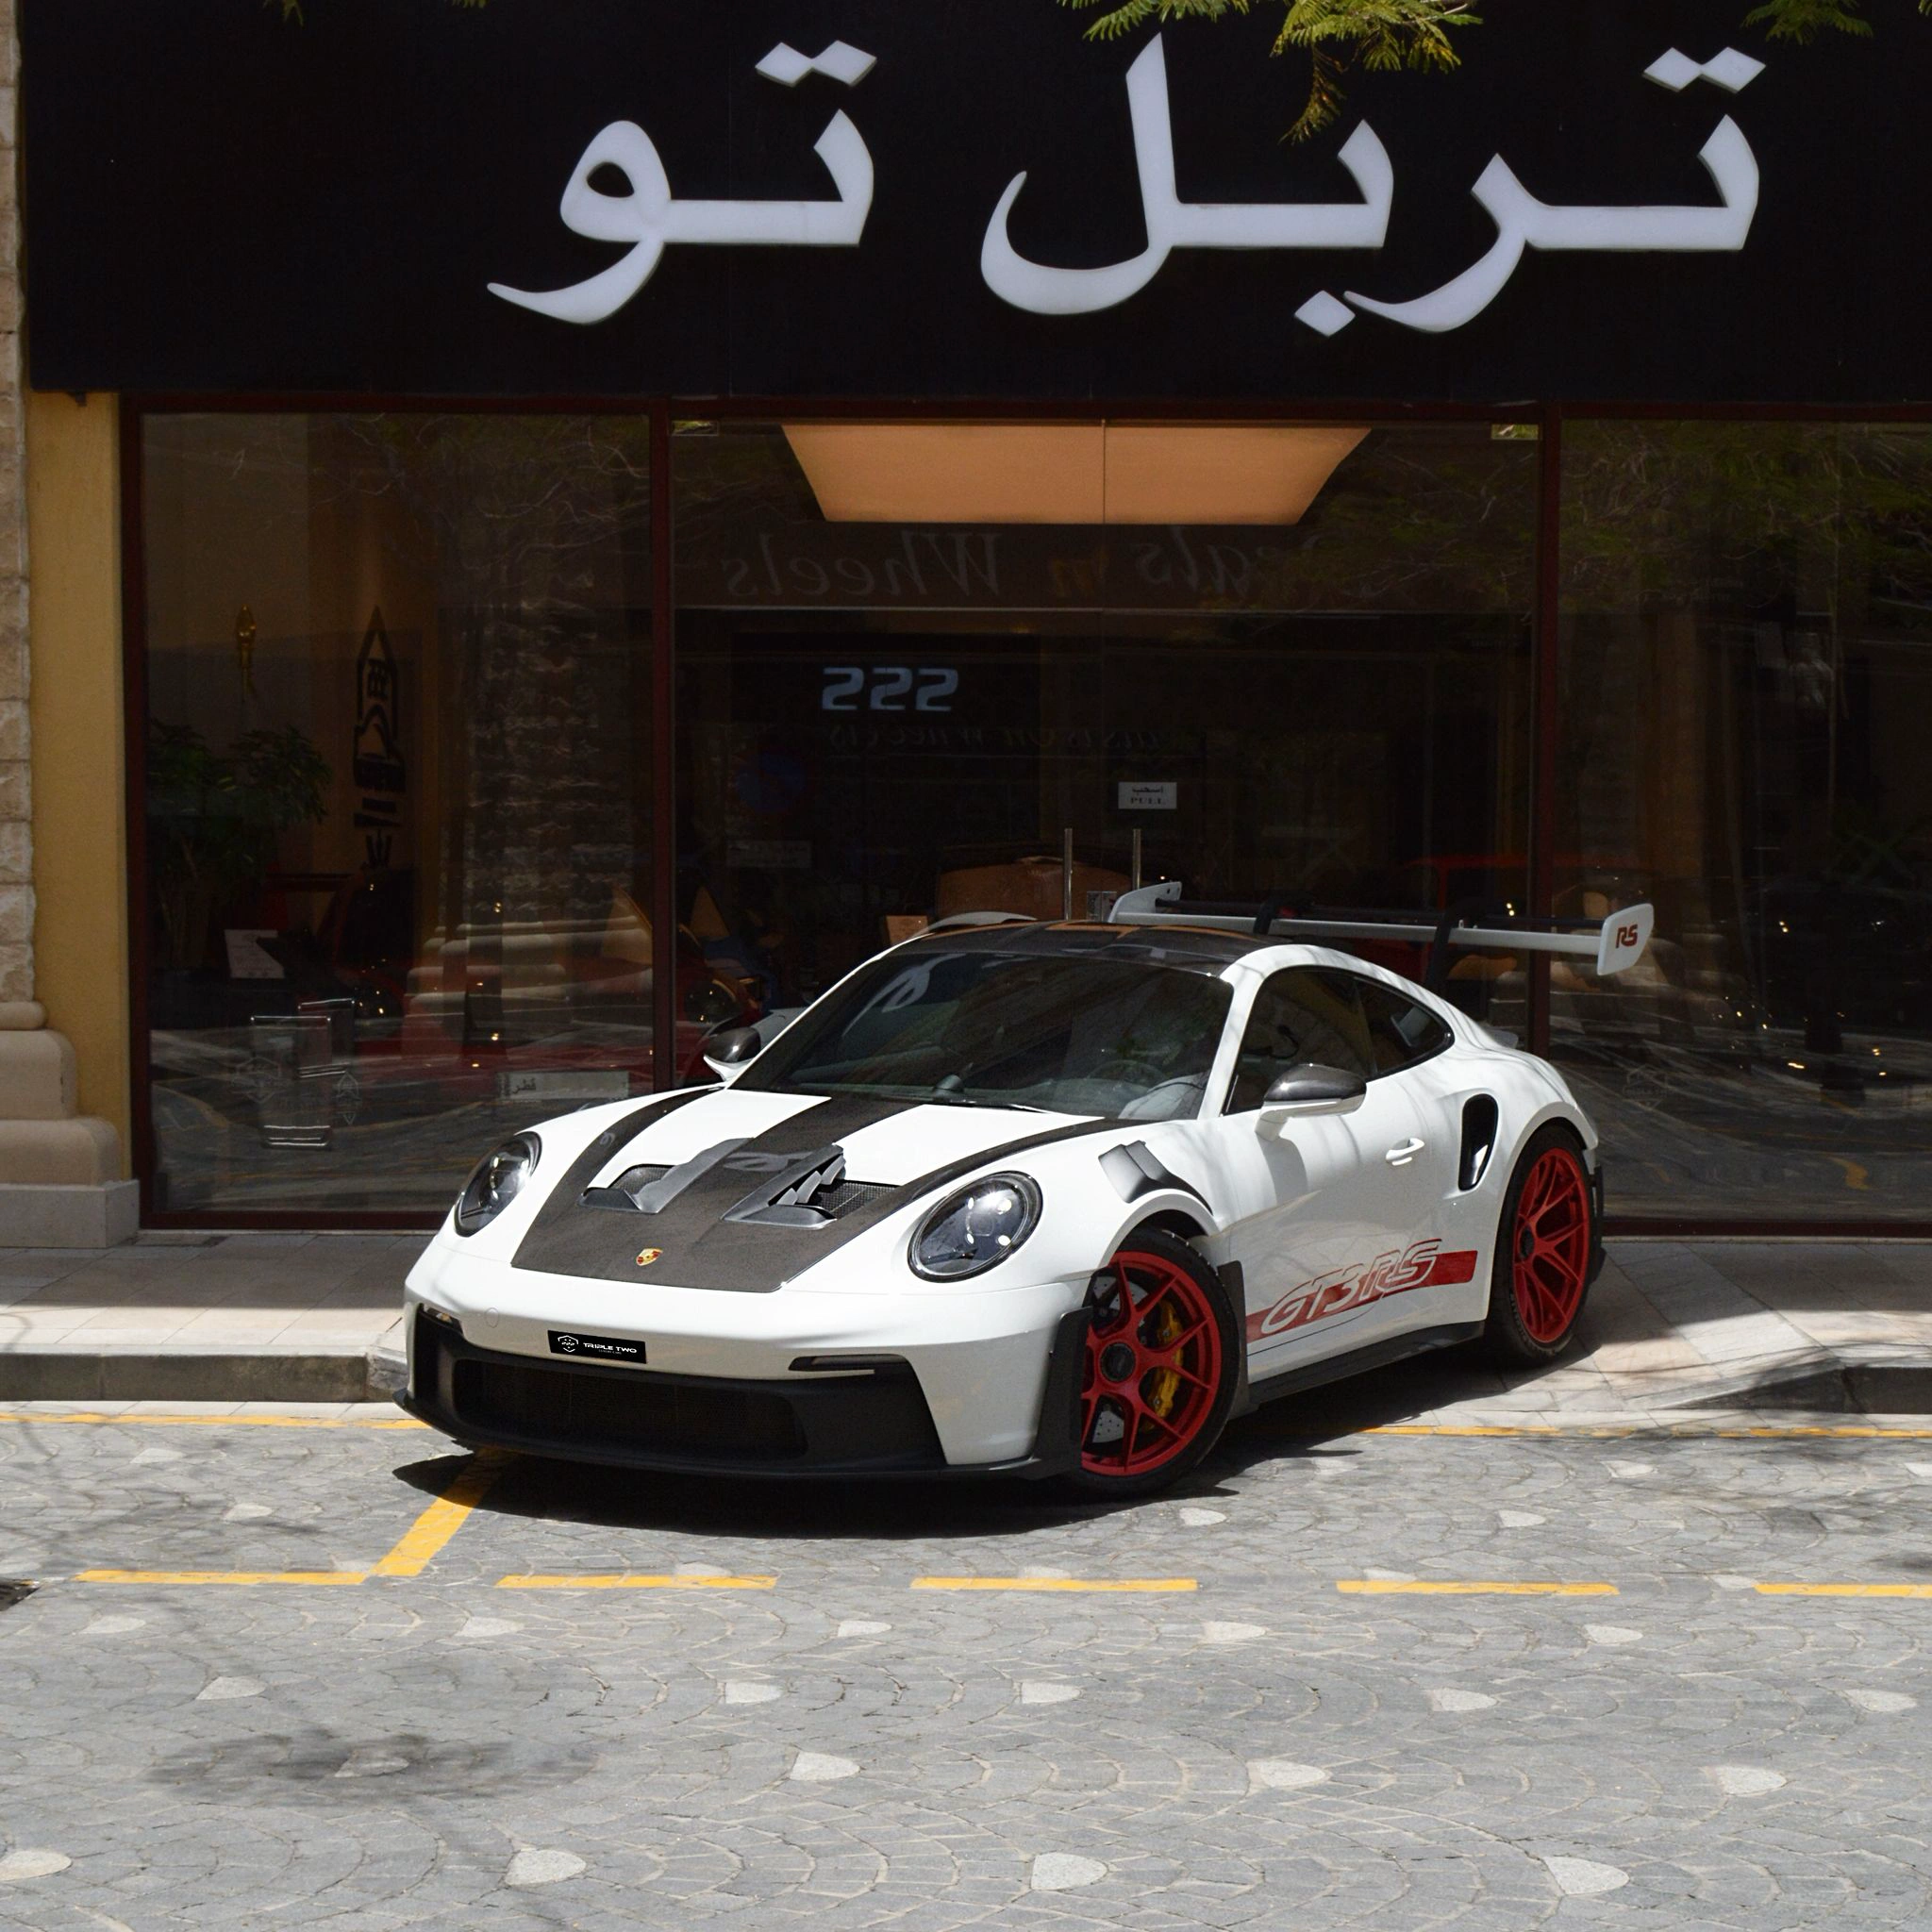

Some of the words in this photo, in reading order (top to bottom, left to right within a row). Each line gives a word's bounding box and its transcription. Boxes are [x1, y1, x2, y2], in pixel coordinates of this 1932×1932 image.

[487, 40, 877, 325] تو
[821, 666, 959, 711] 222
[1615, 924, 1639, 949] RS
[583, 1341, 614, 1351] TRIPLE
